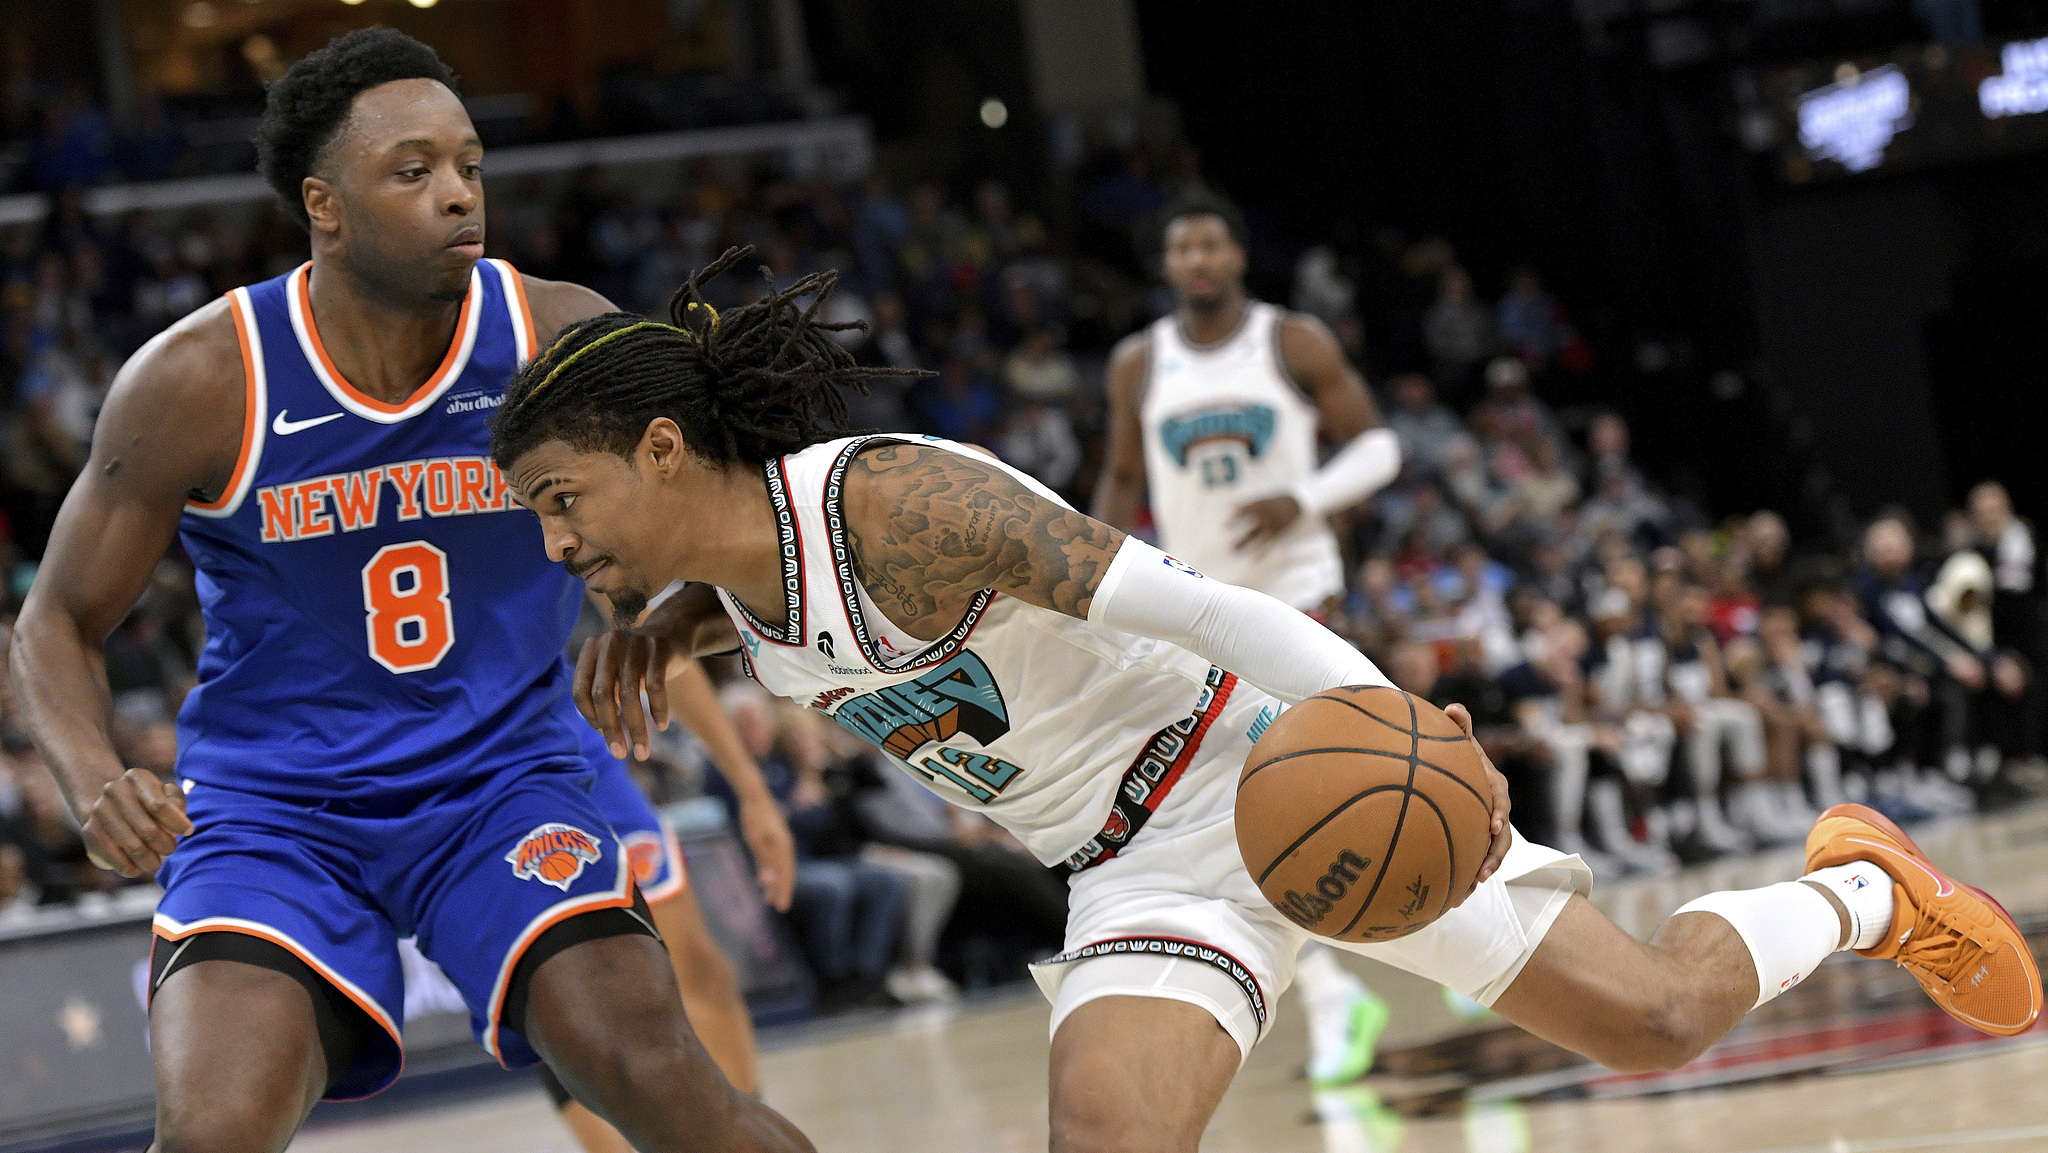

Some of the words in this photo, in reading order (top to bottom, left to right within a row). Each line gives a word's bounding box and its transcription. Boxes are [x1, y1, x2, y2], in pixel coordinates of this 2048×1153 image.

[446, 400, 474, 415] abu
[474, 393, 507, 410] dha
[256, 469, 382, 543] NEW
[361, 540, 455, 675] 8
[828, 664, 872, 675] Robinhood
[1246, 705, 1273, 744] NIKE
[919, 746, 1025, 805] 12
[517, 829, 597, 872] KNICKS
[1273, 849, 1371, 931] ilson
